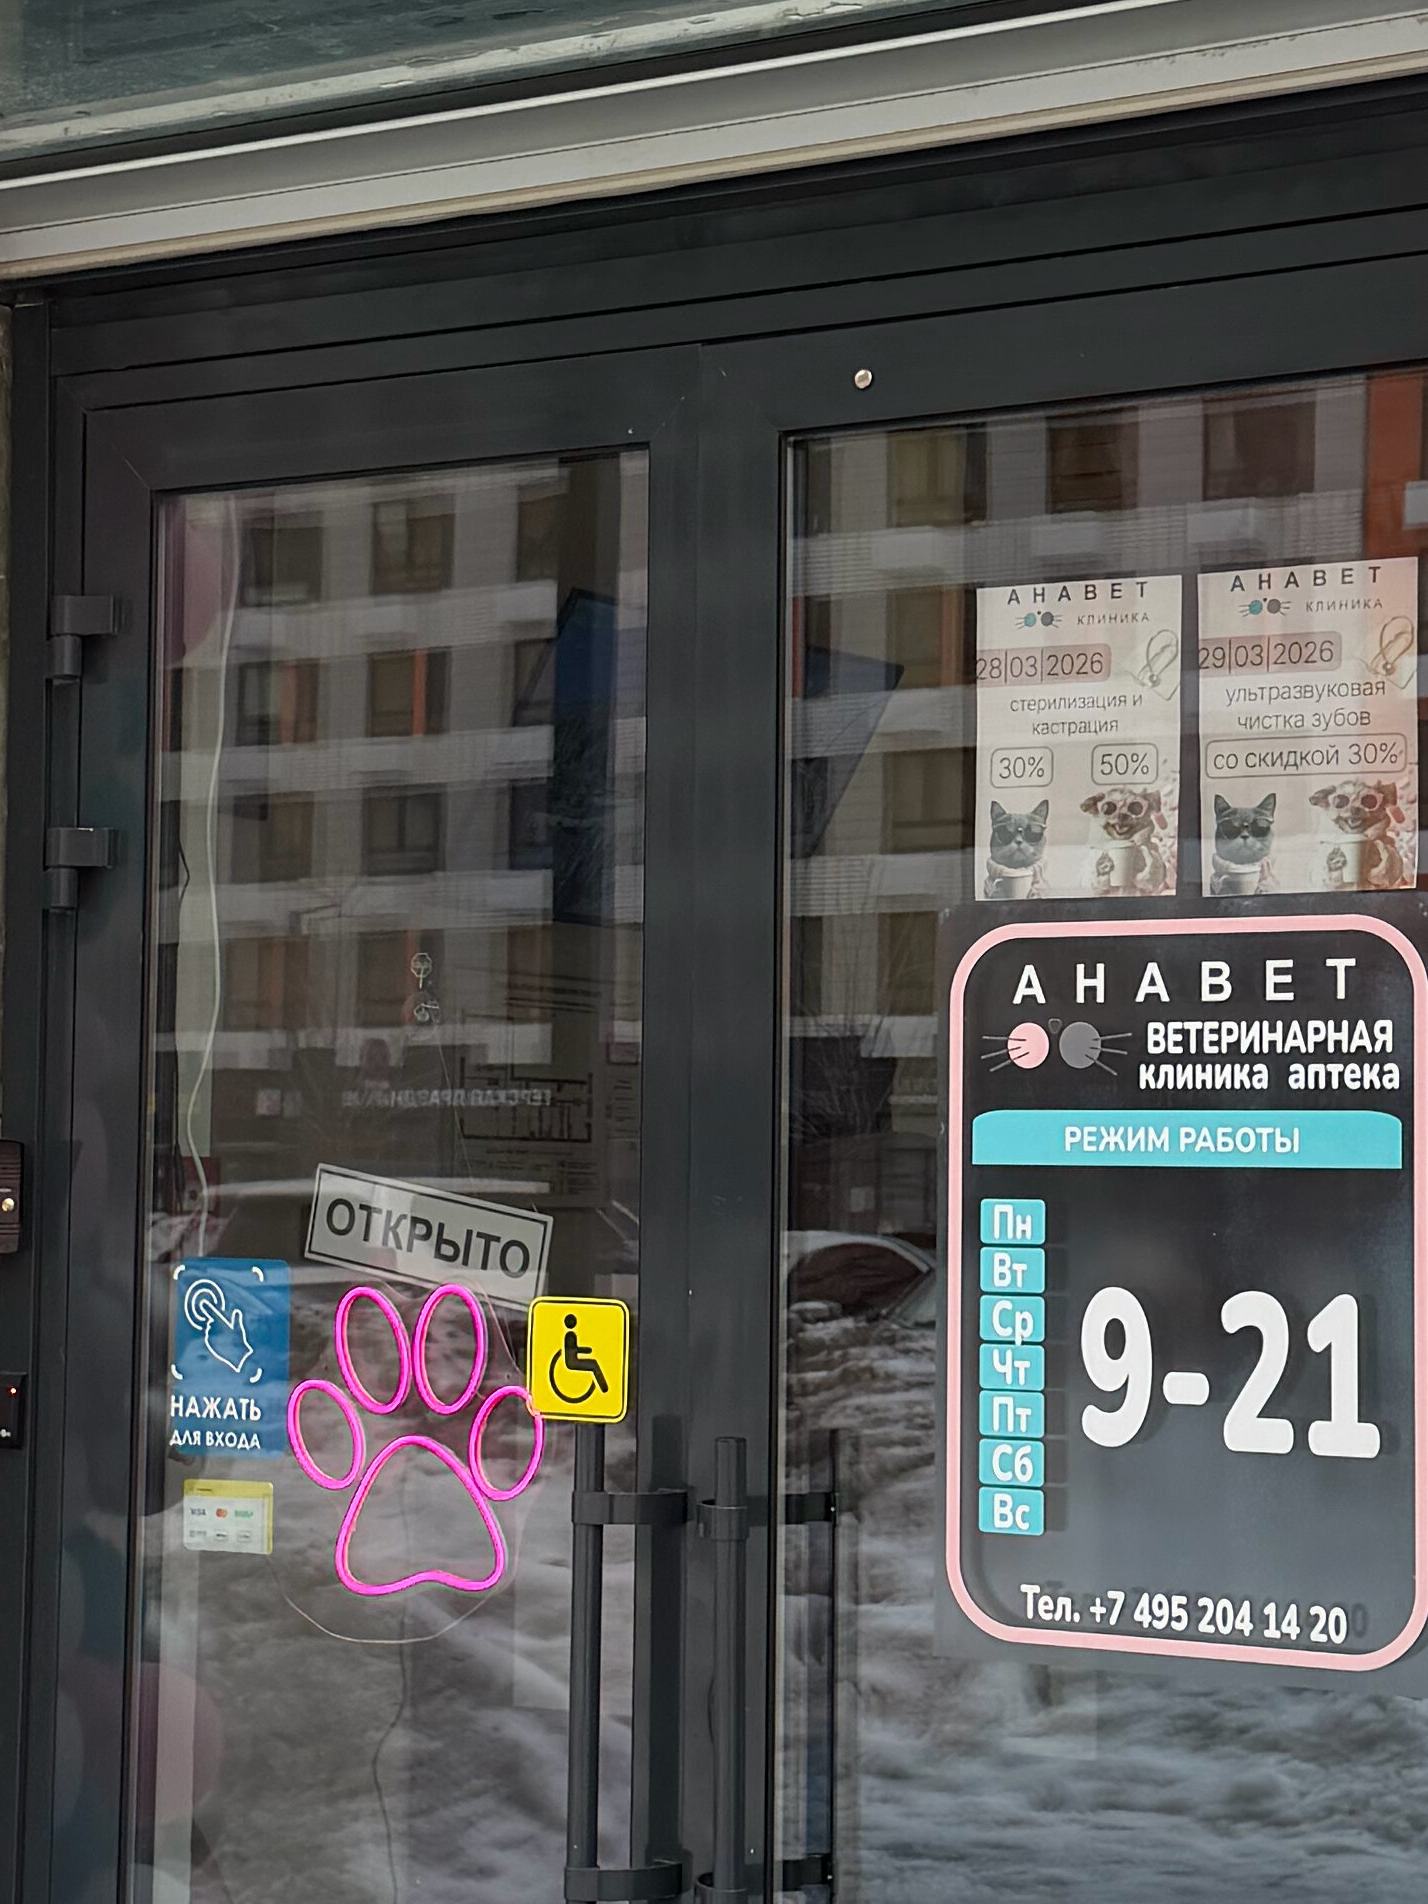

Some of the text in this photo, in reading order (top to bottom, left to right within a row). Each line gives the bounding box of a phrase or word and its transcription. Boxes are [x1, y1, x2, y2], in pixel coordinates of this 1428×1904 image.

[1007, 581, 1149, 605] АНАВЕТ
[1230, 566, 1382, 592] АНАВЕТ
[1076, 612, 1151, 626] КЛИНИКА
[1305, 598, 1384, 613] КЛИНИКА
[1009, 695, 1144, 714] стерилизация и
[1225, 680, 1386, 707] ультразвуковая
[1031, 720, 1119, 737] кастрация
[1237, 708, 1372, 732] чистка зубов
[998, 756, 1045, 779] 30%
[1099, 752, 1150, 776] 50%
[1213, 742, 1399, 771] со скидкой 30%
[1013, 958, 1356, 1005] АНАВЕТ
[1147, 1018, 1394, 1056] ВЕТЕРИНАРНАЯ
[1138, 1062, 1401, 1091] клиника аптека
[1064, 1125, 1301, 1155] РЕЖИМ РАБОТЫ
[992, 1203, 1032, 1241] Пн
[325, 1197, 531, 1279] ОТКРЫТО
[992, 1252, 1028, 1289] Вт
[991, 1301, 1034, 1346] Ср
[992, 1348, 1031, 1386] Чт
[1080, 1286, 1382, 1459] 9-21
[169, 1395, 262, 1422] НАЖАТЬ
[992, 1397, 1032, 1433] Пт
[169, 1429, 262, 1451] ДЛЯ ВХОДА
[991, 1445, 1034, 1483] Сб
[992, 1493, 1031, 1531] Вс
[1019, 1583, 1347, 1645] Тел. +7 495 204 14 20
